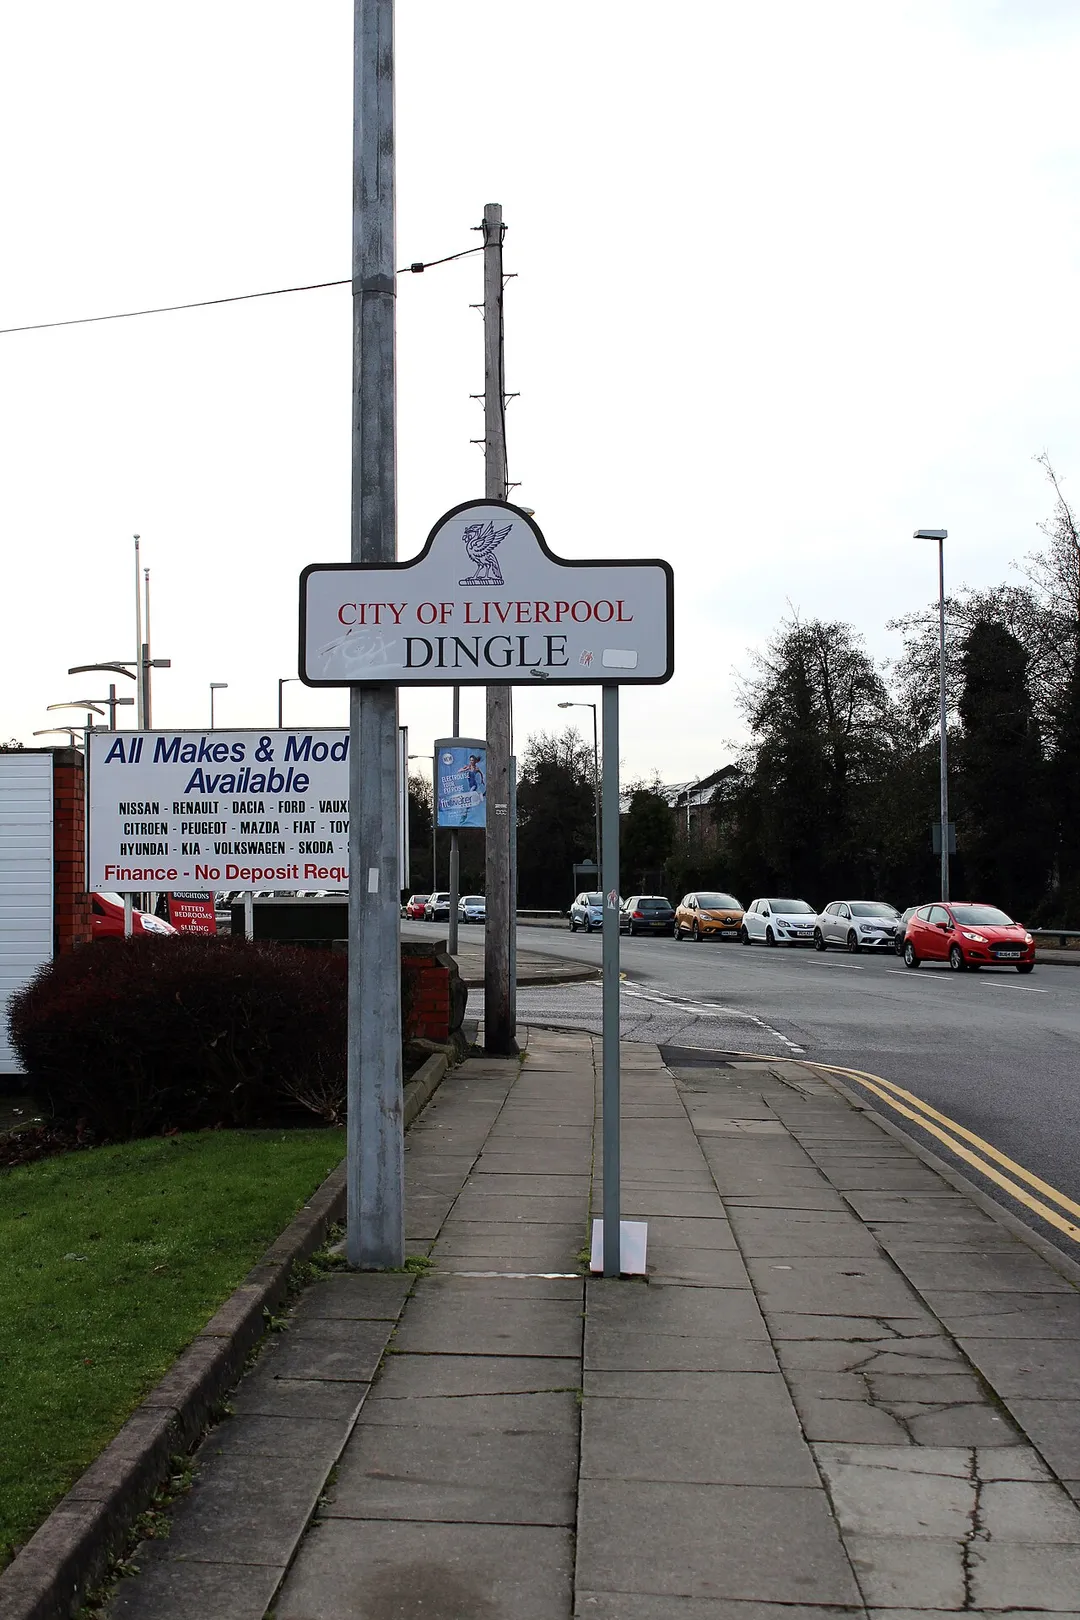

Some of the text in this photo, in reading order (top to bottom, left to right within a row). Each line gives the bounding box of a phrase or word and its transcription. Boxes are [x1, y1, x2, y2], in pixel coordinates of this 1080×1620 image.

[338, 600, 633, 625] CITY OF LIVERPOOL
[403, 635, 569, 668] DINGLE
[104, 737, 143, 763] All
[153, 736, 245, 763] Makes
[254, 735, 275, 762] &
[184, 766, 309, 794] Available
[119, 801, 159, 815] NISSAN
[172, 801, 219, 815] RENAULT
[232, 800, 265, 814] DACIA
[279, 800, 305, 814] FORD
[319, 800, 349, 814] VAUX
[123, 822, 168, 836] CITROEN
[181, 821, 227, 835] PEUGEOT
[240, 820, 280, 834] MAZDA
[293, 820, 316, 834] FIAT
[120, 843, 168, 856] HYUNDAI
[181, 842, 200, 856] KIA
[214, 841, 285, 855] VOLKSWAGEN
[298, 841, 334, 854] SKODA
[104, 864, 177, 881] Finance
[195, 864, 220, 880] No
[225, 864, 299, 883] Deposit
[174, 911, 213, 919] BEDROOMS
[180, 924, 209, 932] SLIDING
